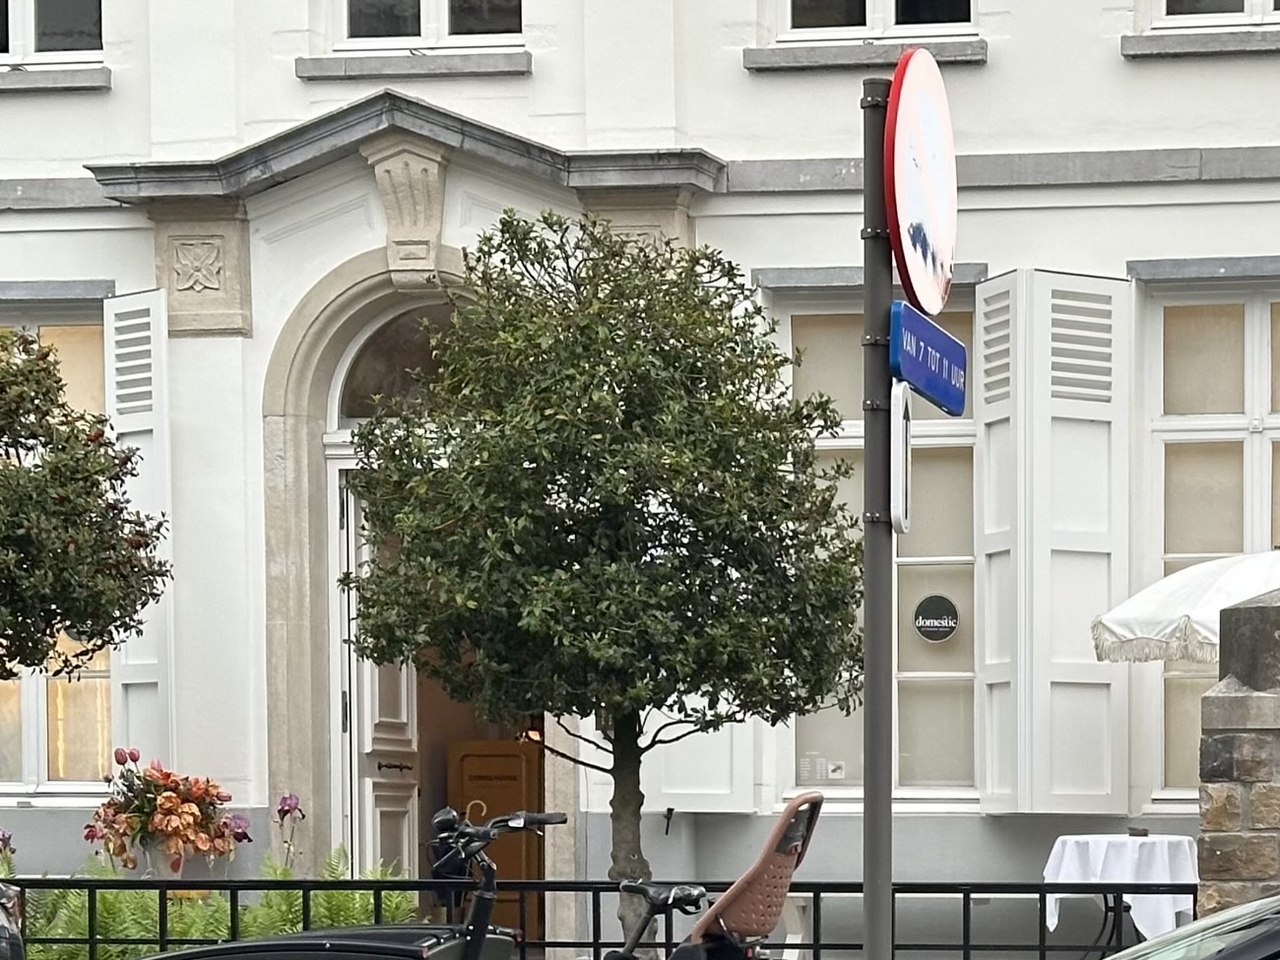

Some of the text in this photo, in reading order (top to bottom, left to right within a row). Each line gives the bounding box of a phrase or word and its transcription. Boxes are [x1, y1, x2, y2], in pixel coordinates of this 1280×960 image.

[902, 327, 965, 392] VAN 7 TOT 11 UUR
[915, 615, 957, 627] domestic
